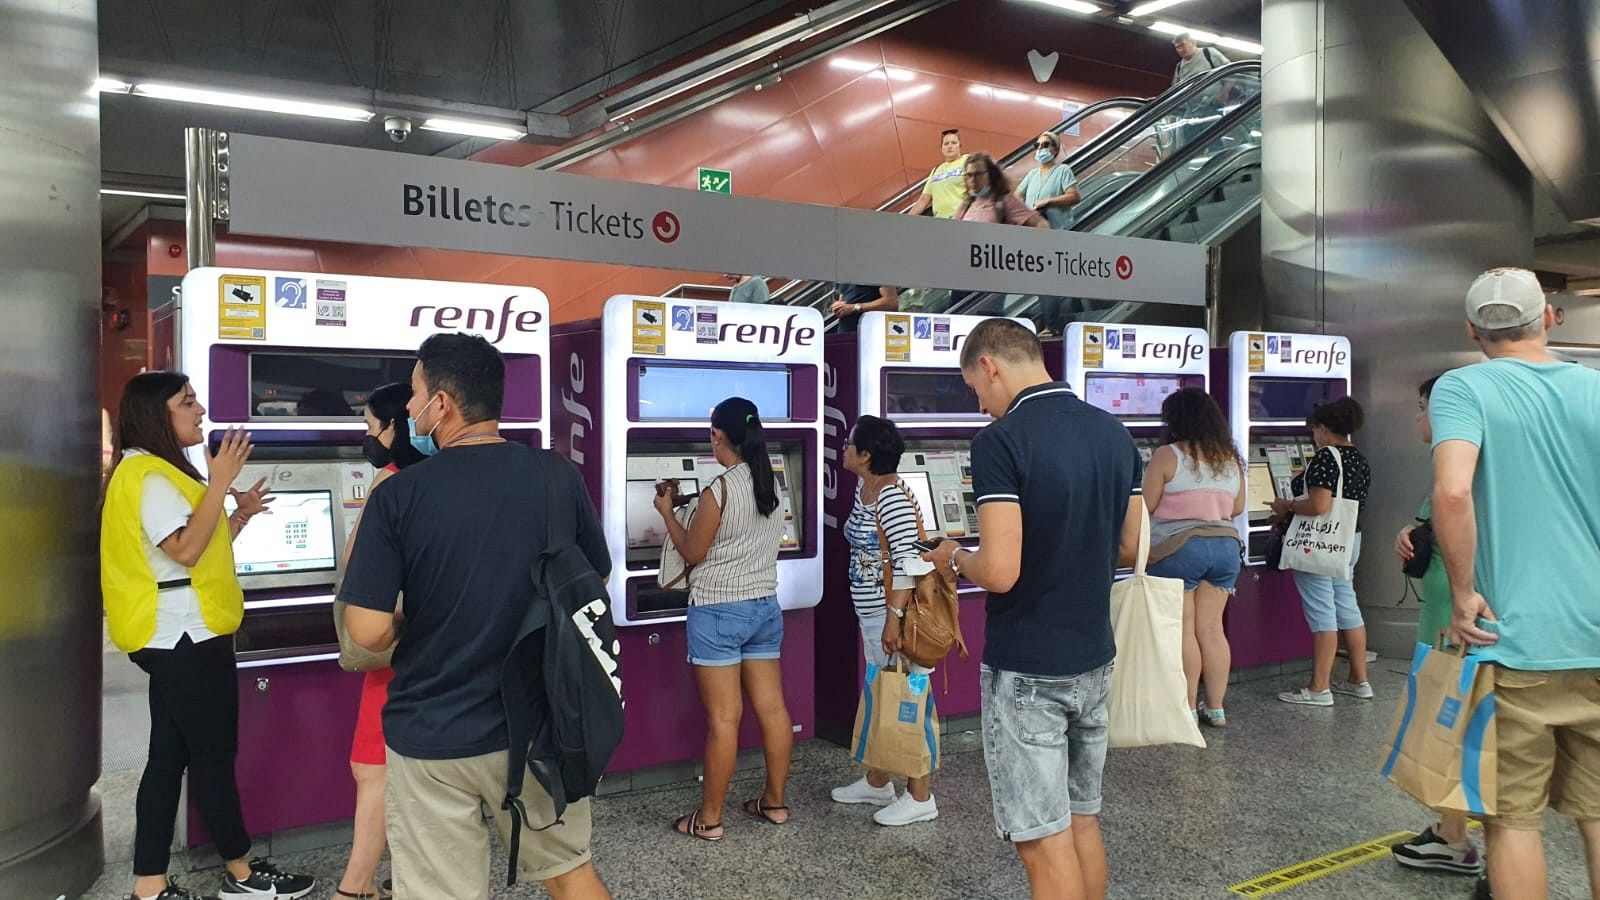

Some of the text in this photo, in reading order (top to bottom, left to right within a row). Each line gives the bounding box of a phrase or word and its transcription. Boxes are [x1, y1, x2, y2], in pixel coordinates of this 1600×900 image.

[403, 184, 644, 239] Billetes Tickets
[970, 244, 1111, 278] Billetes Tickets
[410, 295, 542, 344] renfe
[718, 313, 815, 356] renfe
[1142, 334, 1204, 368] renfe
[1295, 341, 1346, 373] renfe
[562, 352, 593, 465] nfe
